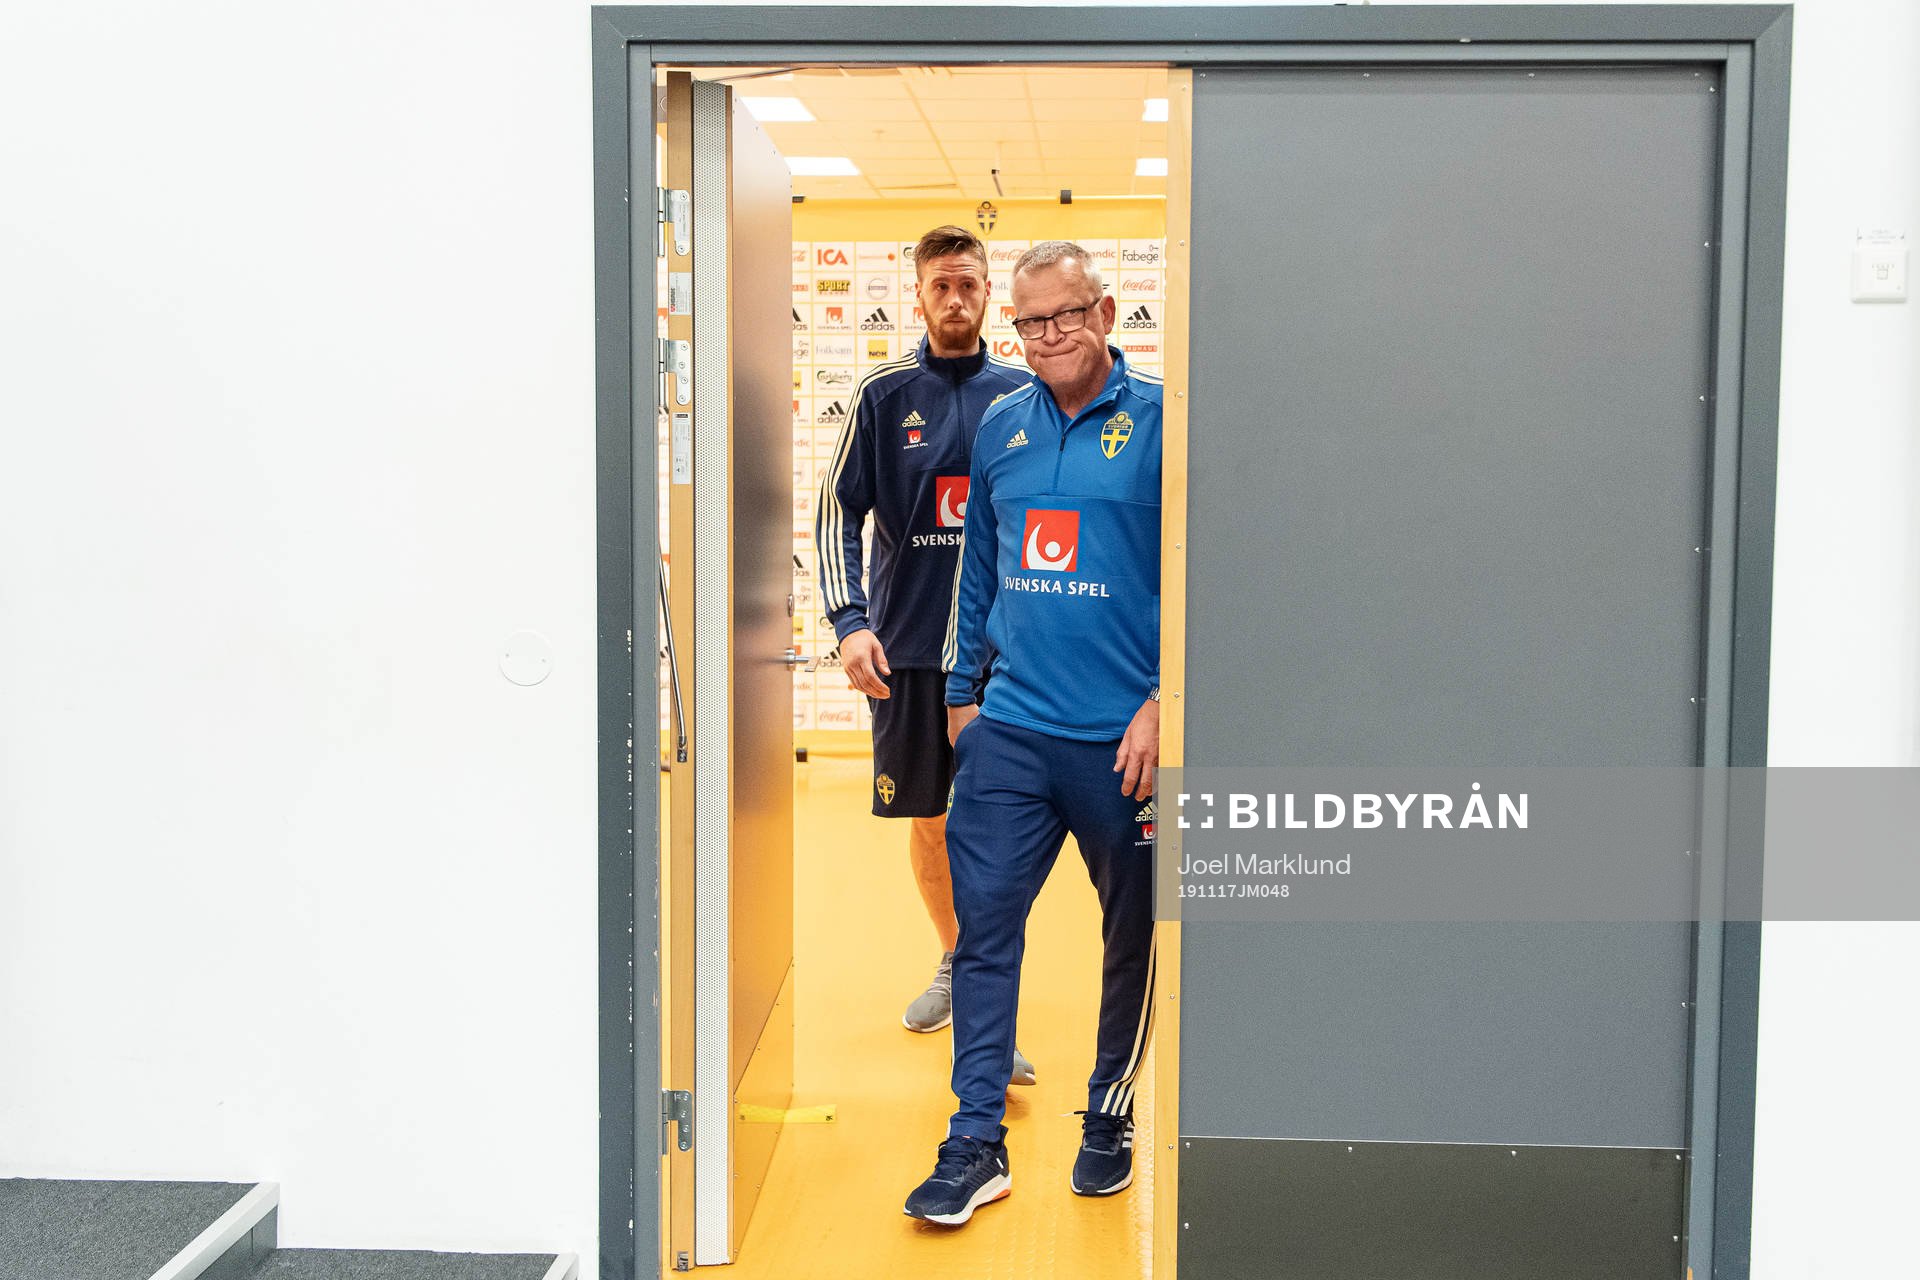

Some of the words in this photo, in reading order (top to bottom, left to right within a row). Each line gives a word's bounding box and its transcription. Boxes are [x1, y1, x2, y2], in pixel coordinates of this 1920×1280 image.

[817, 249, 848, 265] ICA
[1122, 250, 1158, 264] Fabege
[817, 280, 851, 291] SPORT
[860, 322, 895, 331] adidas
[1122, 320, 1157, 329] adidas
[993, 341, 1024, 357] ICA
[901, 420, 926, 428] adidas
[1006, 439, 1029, 449] adidas
[912, 534, 965, 548] SVENSK
[1004, 576, 1063, 594] SVENSKA
[1067, 581, 1110, 598] SPEL
